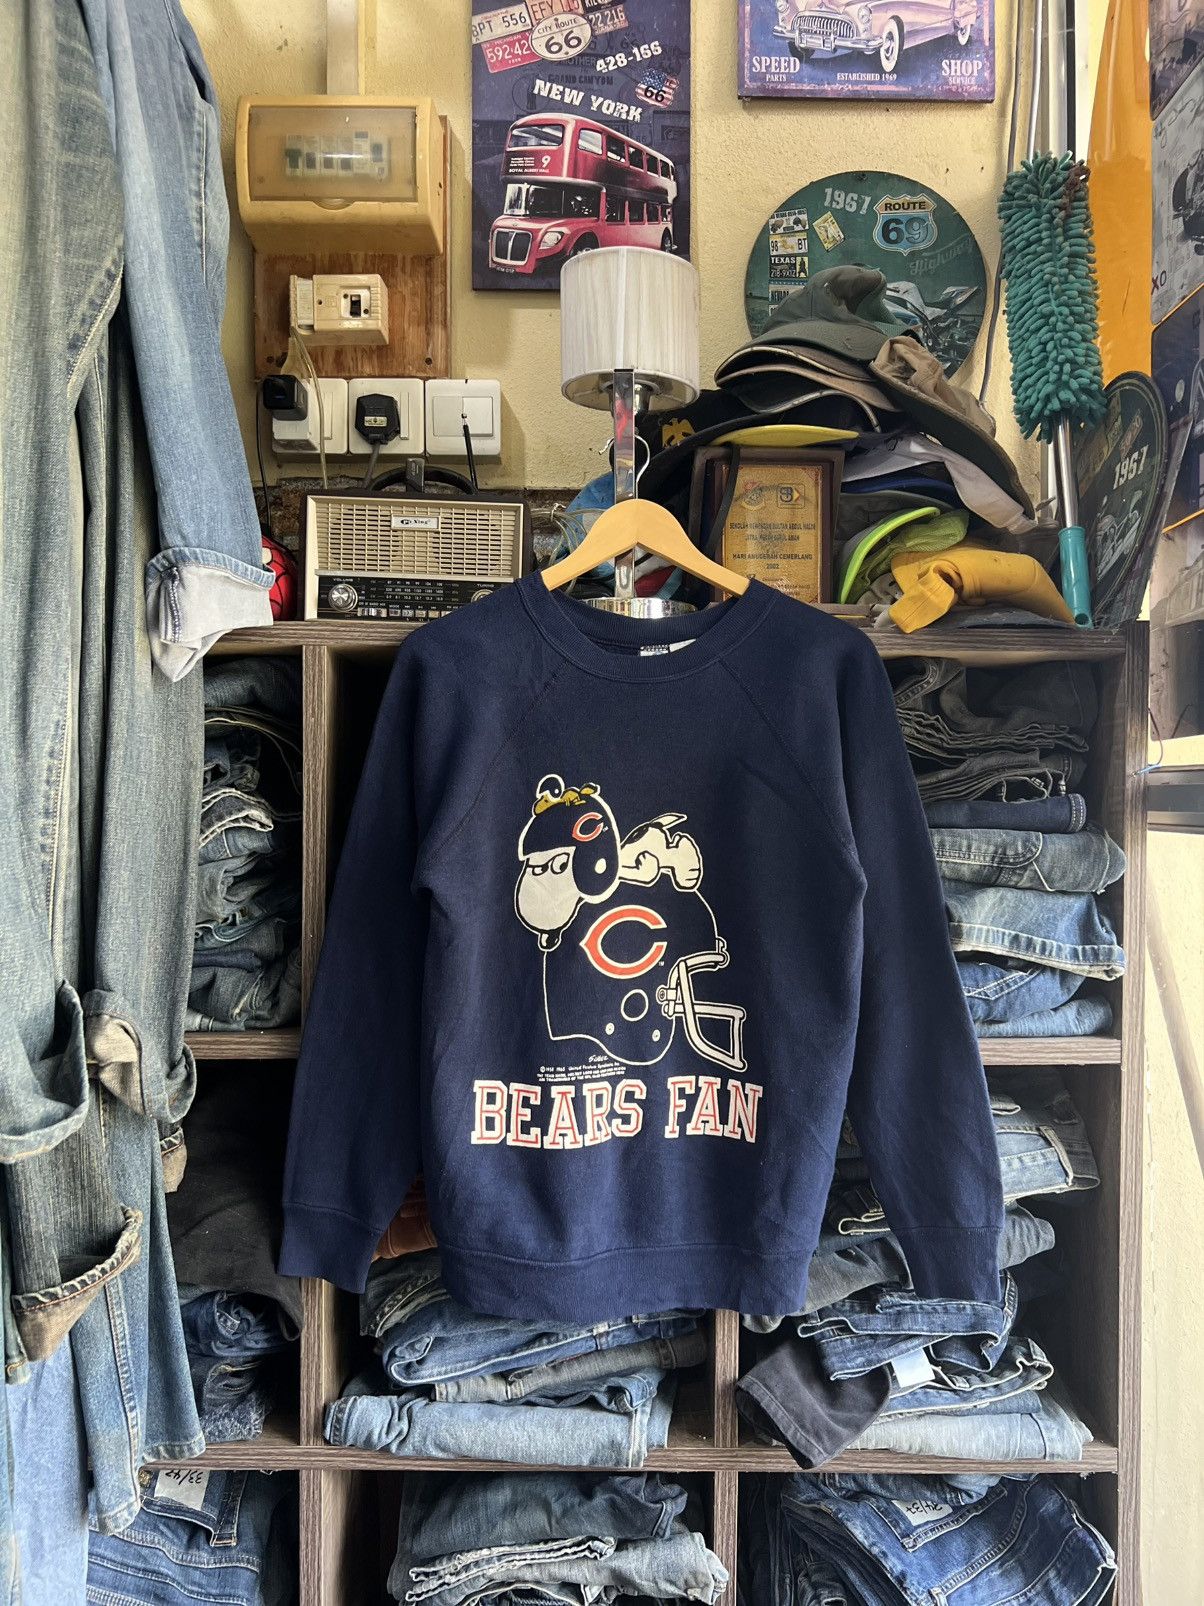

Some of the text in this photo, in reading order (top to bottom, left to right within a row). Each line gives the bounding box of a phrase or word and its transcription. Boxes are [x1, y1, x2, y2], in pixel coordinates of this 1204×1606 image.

[502, 11, 527, 28] 556
[605, 8, 625, 24] 216
[537, 25, 552, 34] CITY
[555, 18, 578, 28] ROUTE
[545, 30, 583, 55] 66
[596, 41, 662, 73] 428-166
[752, 56, 800, 73] SPEED
[941, 59, 983, 76] SHOP
[766, 74, 787, 82] PARTS
[837, 72, 897, 82] ESTABLISHED 1969
[533, 79, 643, 123] NEW YORK
[644, 85, 667, 102] 66
[541, 155, 551, 168] 9
[823, 187, 872, 215] 1967
[884, 201, 927, 212] ROUTE
[881, 217, 929, 244] 69
[797, 238, 807, 250] BT
[1113, 444, 1149, 490] 1967
[470, 1075, 763, 1149] BEARS FAN
